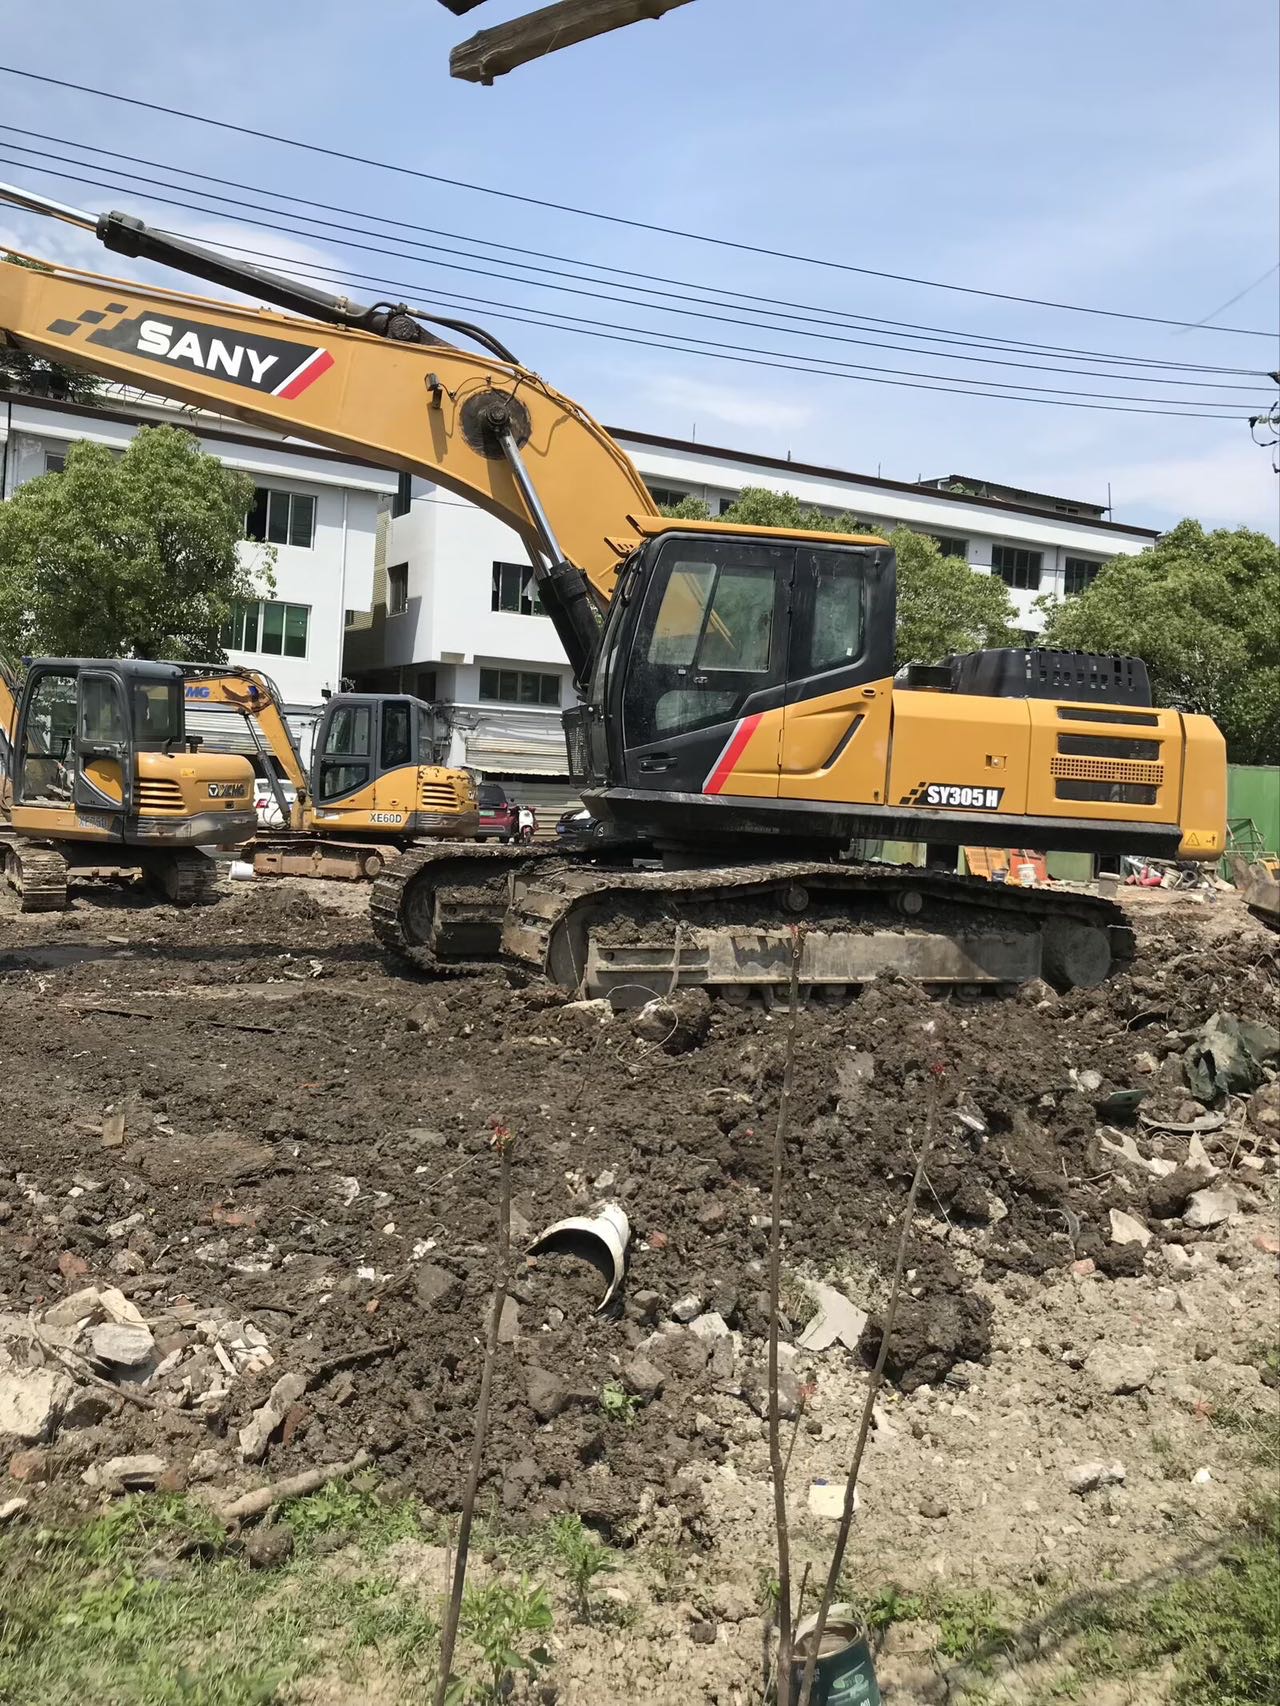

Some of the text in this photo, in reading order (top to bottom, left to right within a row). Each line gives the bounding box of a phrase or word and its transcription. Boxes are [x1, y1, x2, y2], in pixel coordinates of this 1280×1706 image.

[137, 320, 279, 384] SANY
[185, 687, 210, 698] MG
[927, 785, 998, 808] SY305H
[369, 813, 402, 823] XE60D
